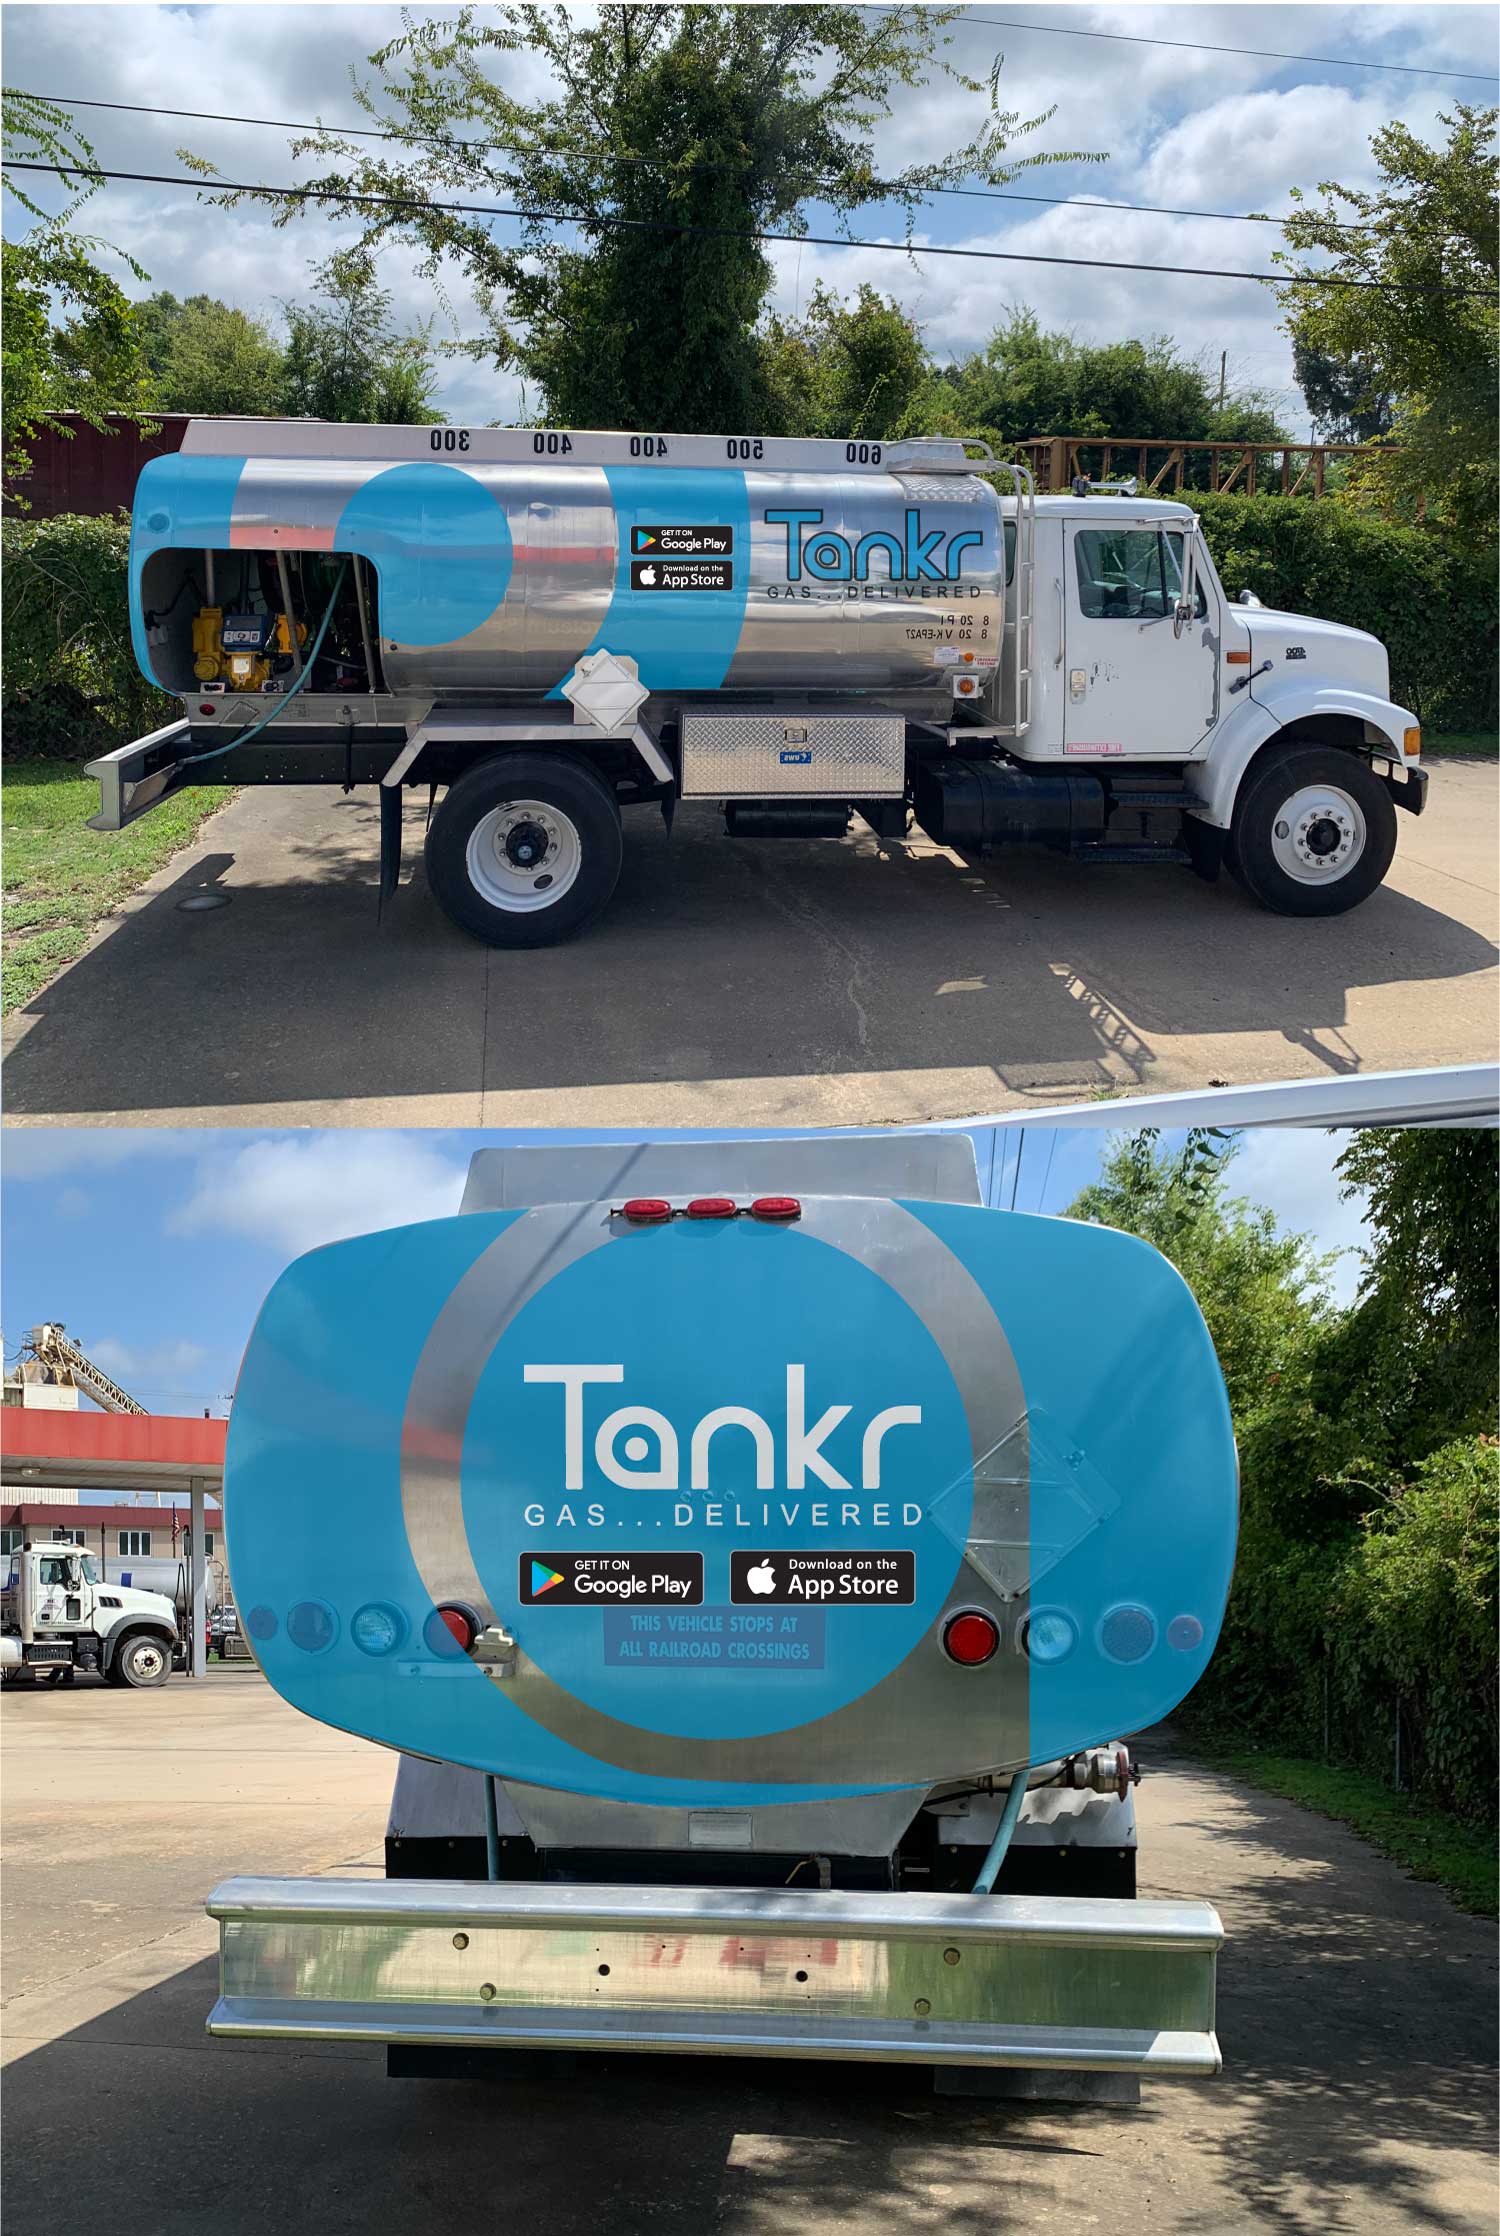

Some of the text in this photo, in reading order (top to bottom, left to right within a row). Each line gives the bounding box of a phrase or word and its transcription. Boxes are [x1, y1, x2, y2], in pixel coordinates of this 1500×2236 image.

[661, 537, 727, 552] Google Play
[764, 508, 983, 581] Tankr
[662, 564, 699, 572] Download
[711, 564, 724, 572] the
[662, 573, 725, 589] App Store
[523, 1363, 922, 1490] Tankr
[574, 1559, 630, 1571] GET IT ON
[789, 1558, 898, 1570] Download on the
[574, 1573, 692, 1599] Google Play
[788, 1574, 899, 1600] App Store
[630, 1615, 798, 1633] THIS VEHICLE STOPS AT
[619, 1640, 810, 1660] ALL RAILROAD CROSSINGS
